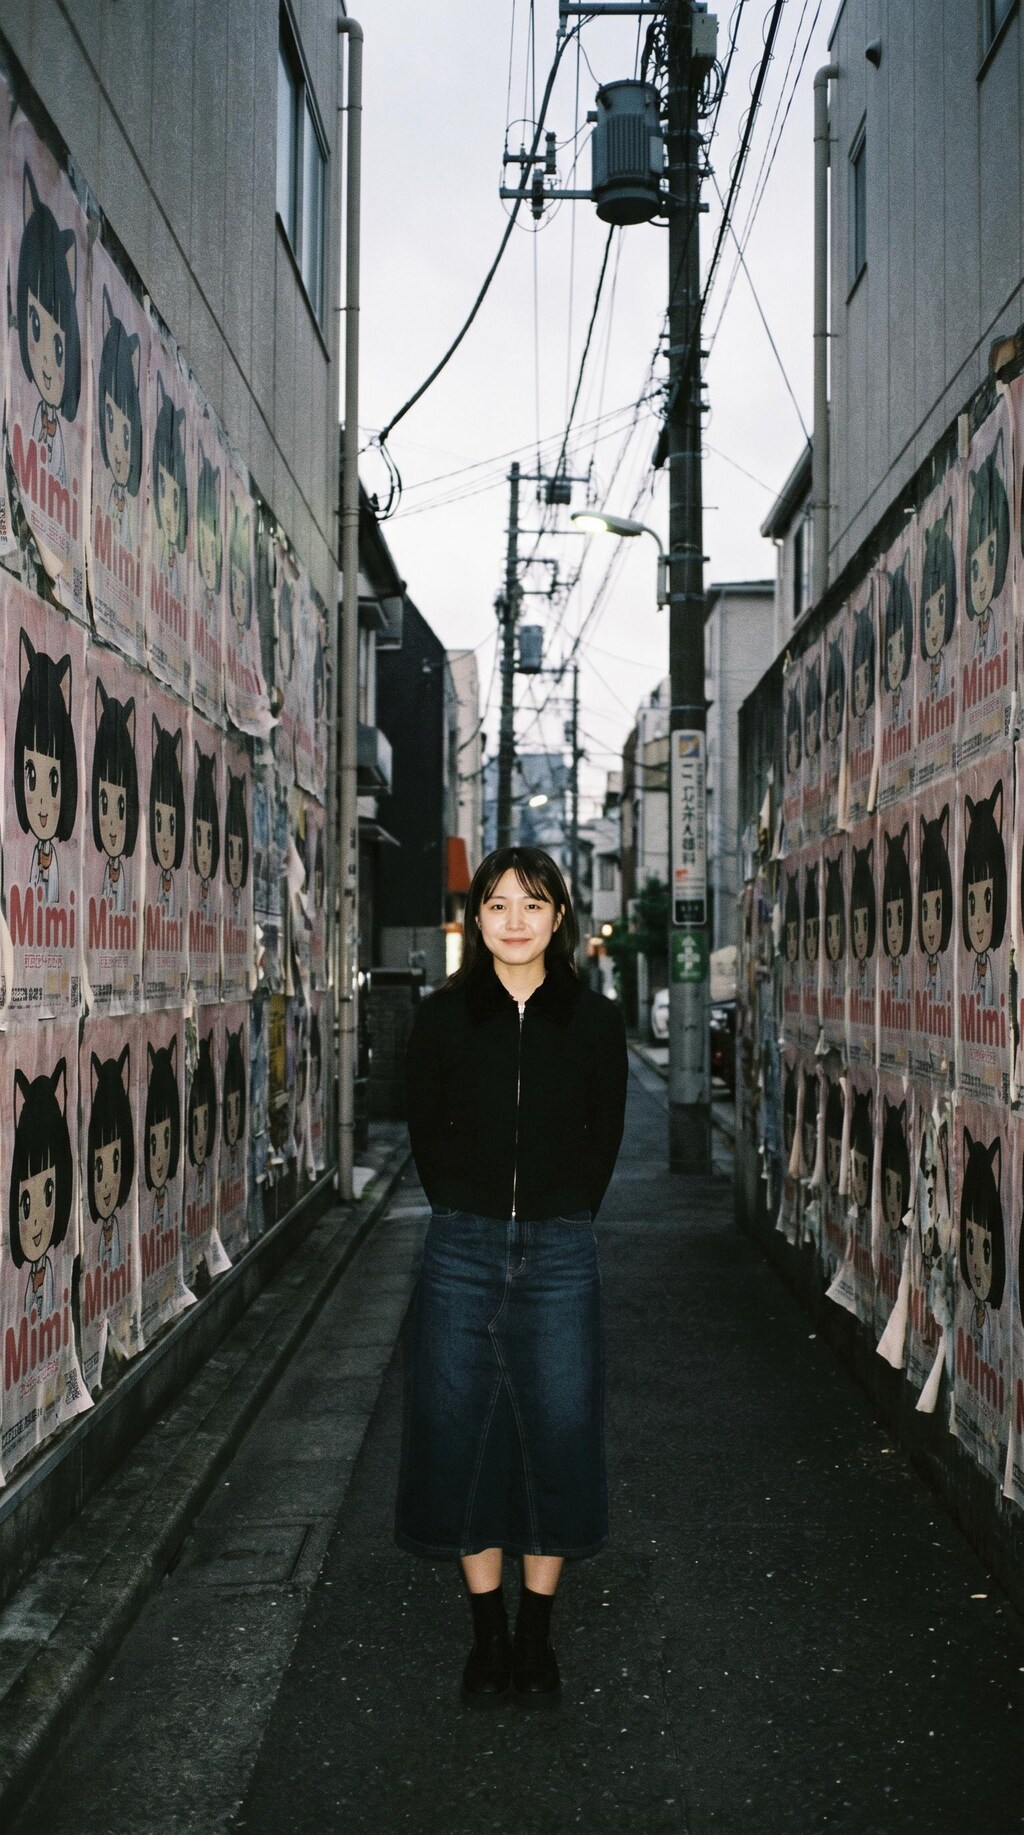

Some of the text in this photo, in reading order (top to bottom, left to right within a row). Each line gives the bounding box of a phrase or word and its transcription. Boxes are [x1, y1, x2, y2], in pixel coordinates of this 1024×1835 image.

[12, 423, 78, 541] Mimi
[95, 505, 141, 598] Mimi
[151, 563, 187, 642] Mimi
[963, 631, 1008, 712] Mimi
[882, 708, 911, 766] Mimi
[918, 676, 955, 744] Mimi
[10, 884, 75, 949] Mimi
[88, 896, 137, 950] Mimi
[146, 903, 183, 952] Mimi
[189, 910, 217, 953] Mimi
[223, 916, 247, 954] Mimi
[849, 987, 874, 1025] Mimi
[880, 988, 911, 1031] Mimi
[915, 989, 951, 1038] Mimi
[960, 992, 1006, 1049] Mimi
[141, 1211, 179, 1281] Mimi
[84, 1242, 132, 1329] Mimi
[5, 1287, 69, 1391] Mimi
[957, 1327, 1004, 1416] Mimi
